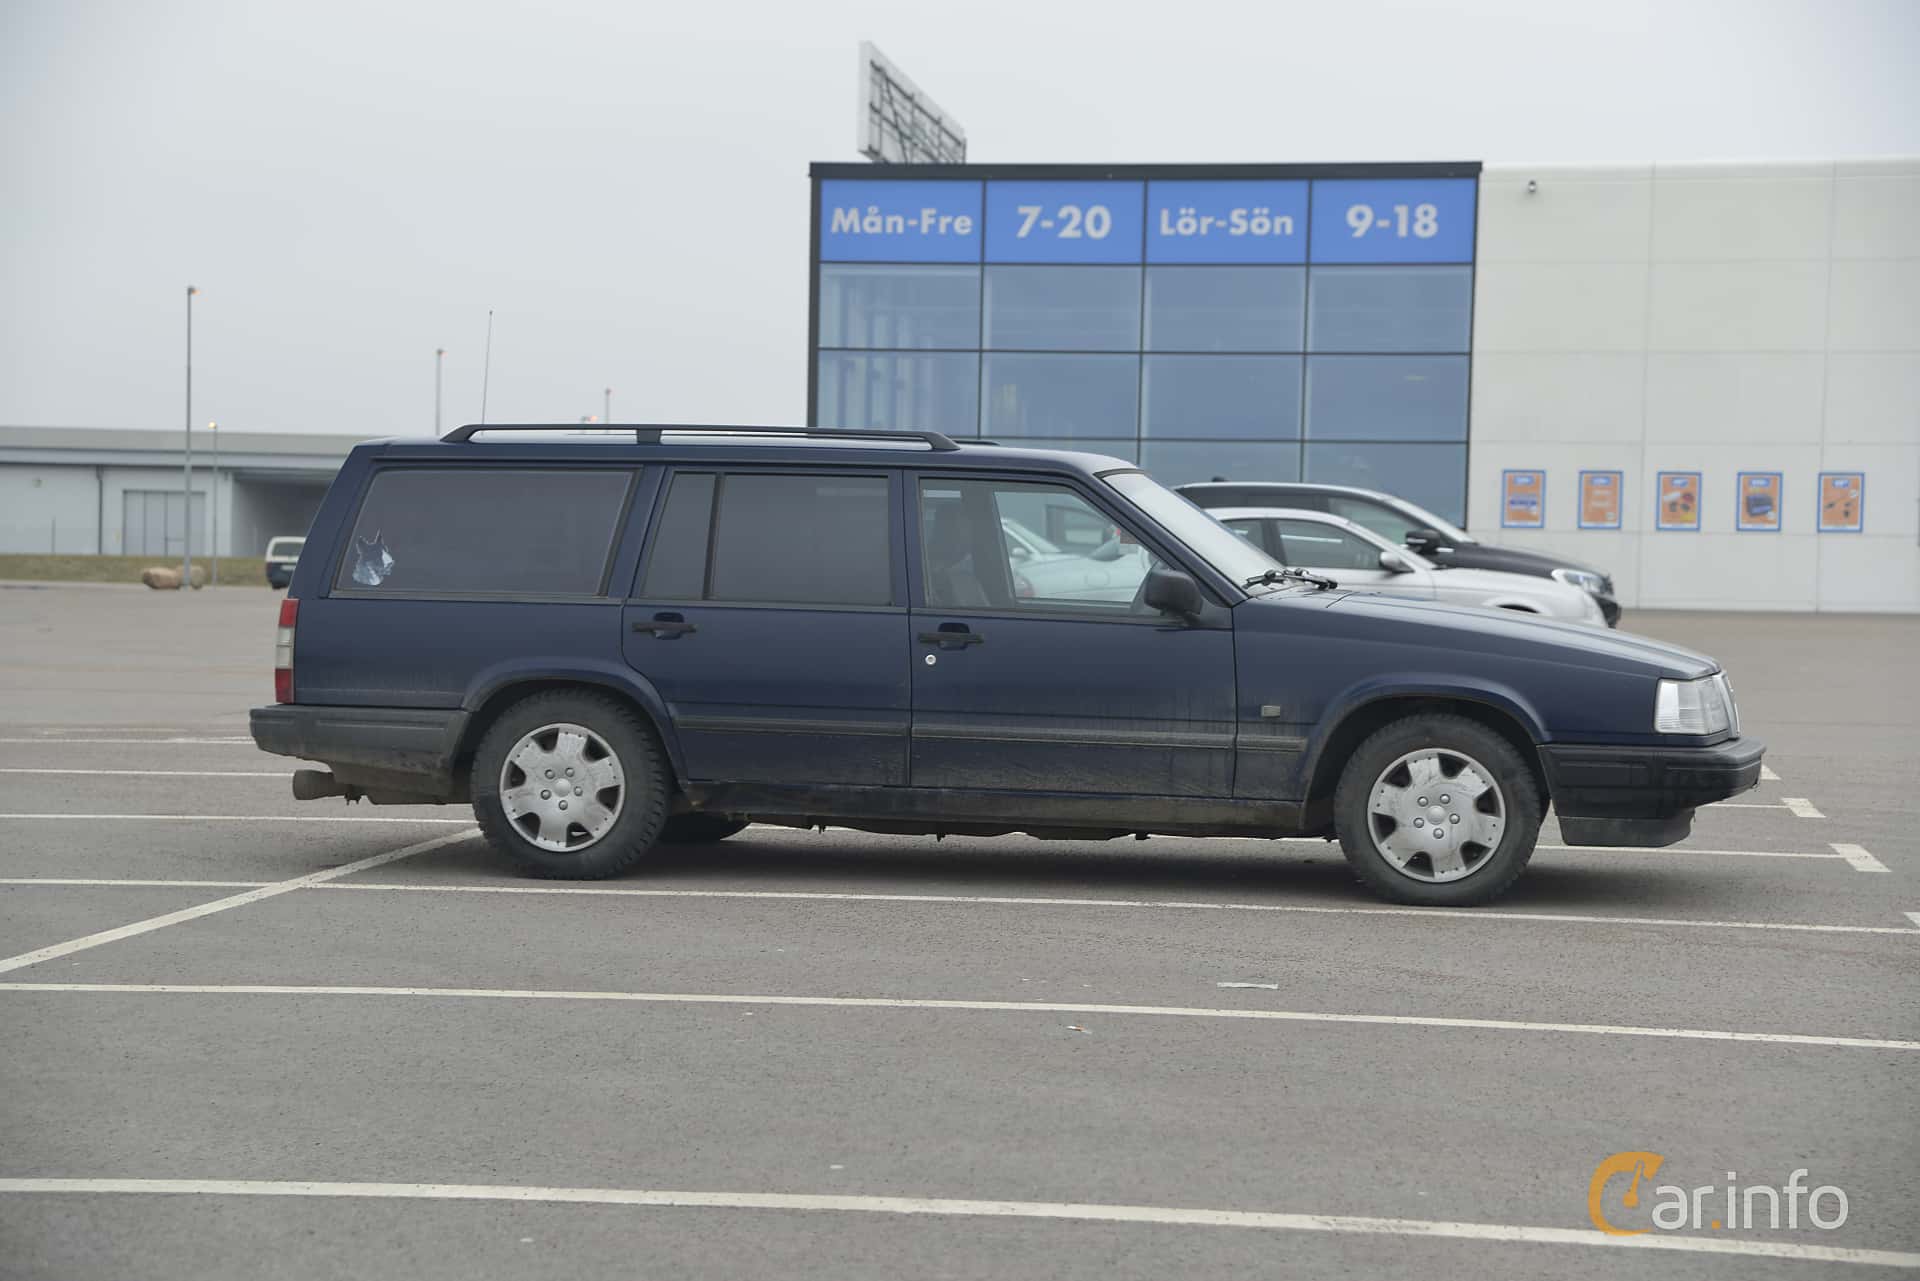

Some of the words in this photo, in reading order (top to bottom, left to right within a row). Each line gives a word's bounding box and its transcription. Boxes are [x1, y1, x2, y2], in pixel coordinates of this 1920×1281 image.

[831, 206, 973, 235] Mån-Fre
[1017, 205, 1111, 239] 7-20
[1160, 207, 1294, 236] Lör-Sön
[1346, 204, 1438, 238] 9-18
